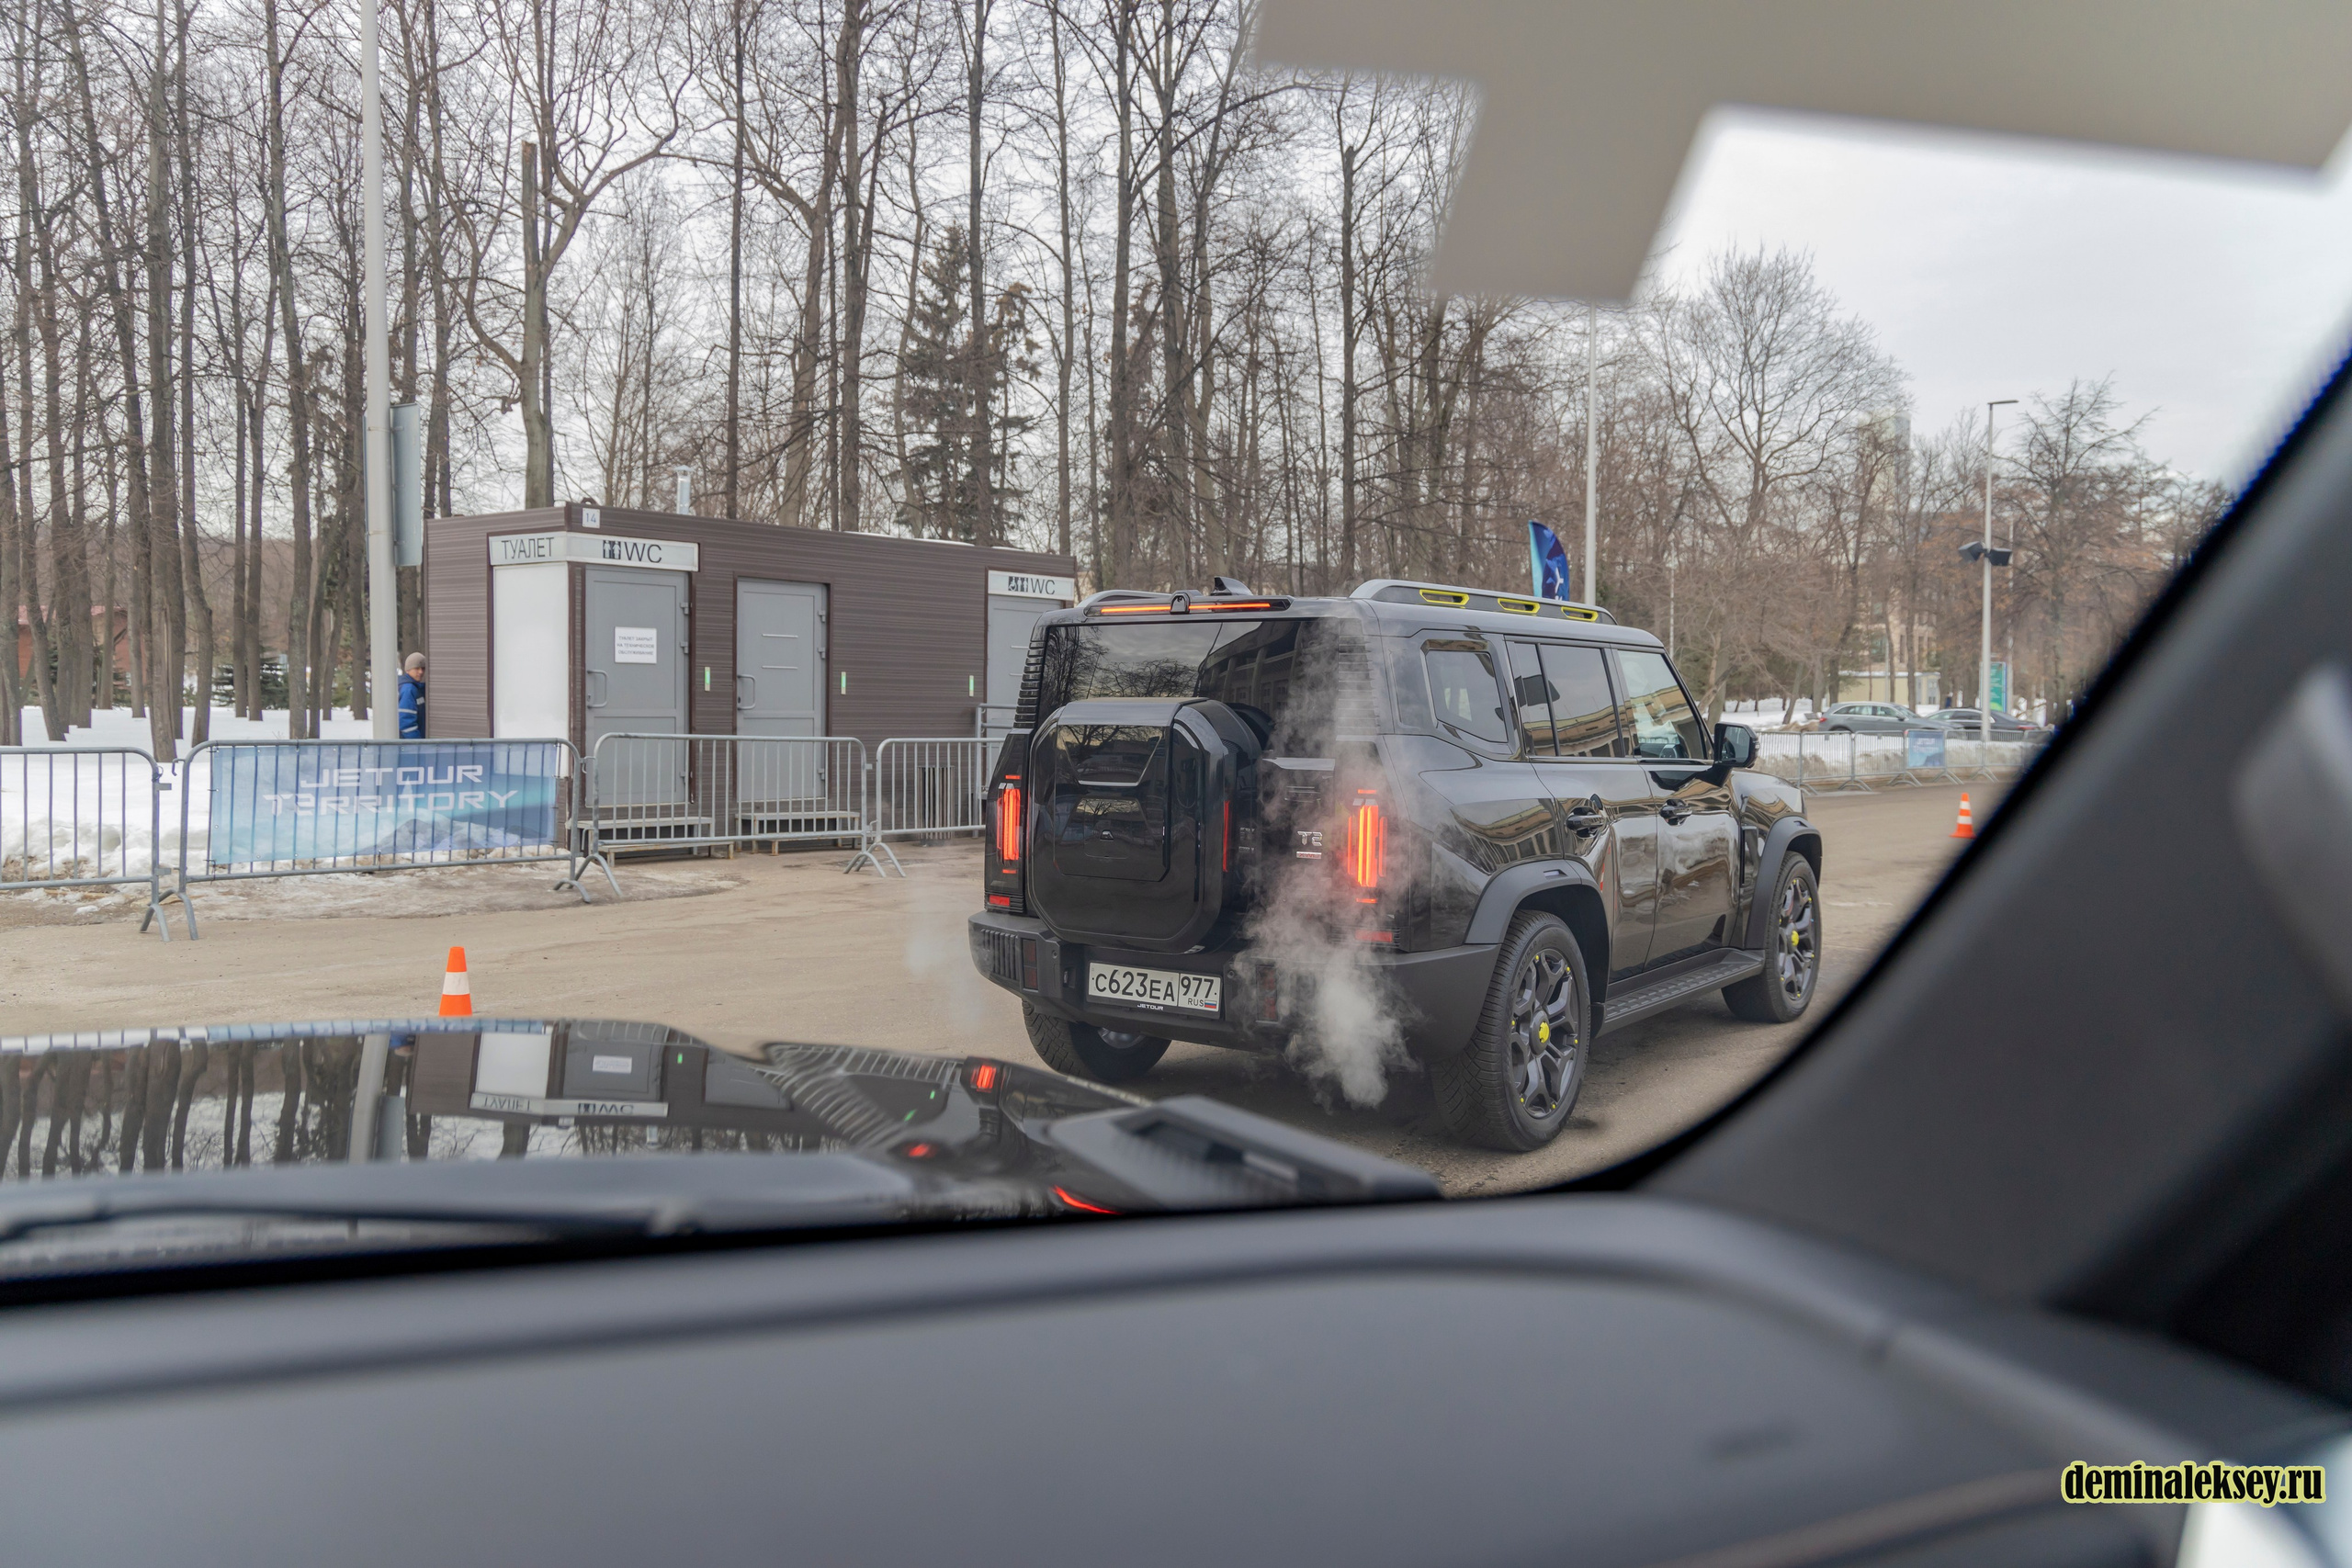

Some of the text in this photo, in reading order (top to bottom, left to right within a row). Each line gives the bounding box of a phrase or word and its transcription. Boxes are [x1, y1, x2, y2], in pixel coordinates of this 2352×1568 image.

[586, 513, 596, 523] 14
[501, 537, 554, 559] ТУАЛЕТ
[624, 541, 662, 563] WC
[1030, 577, 1055, 595] WC
[300, 765, 482, 787] JETOUR
[1297, 830, 1322, 846] T2
[1181, 976, 1214, 998] 977
[1187, 998, 1204, 1007] RUS
